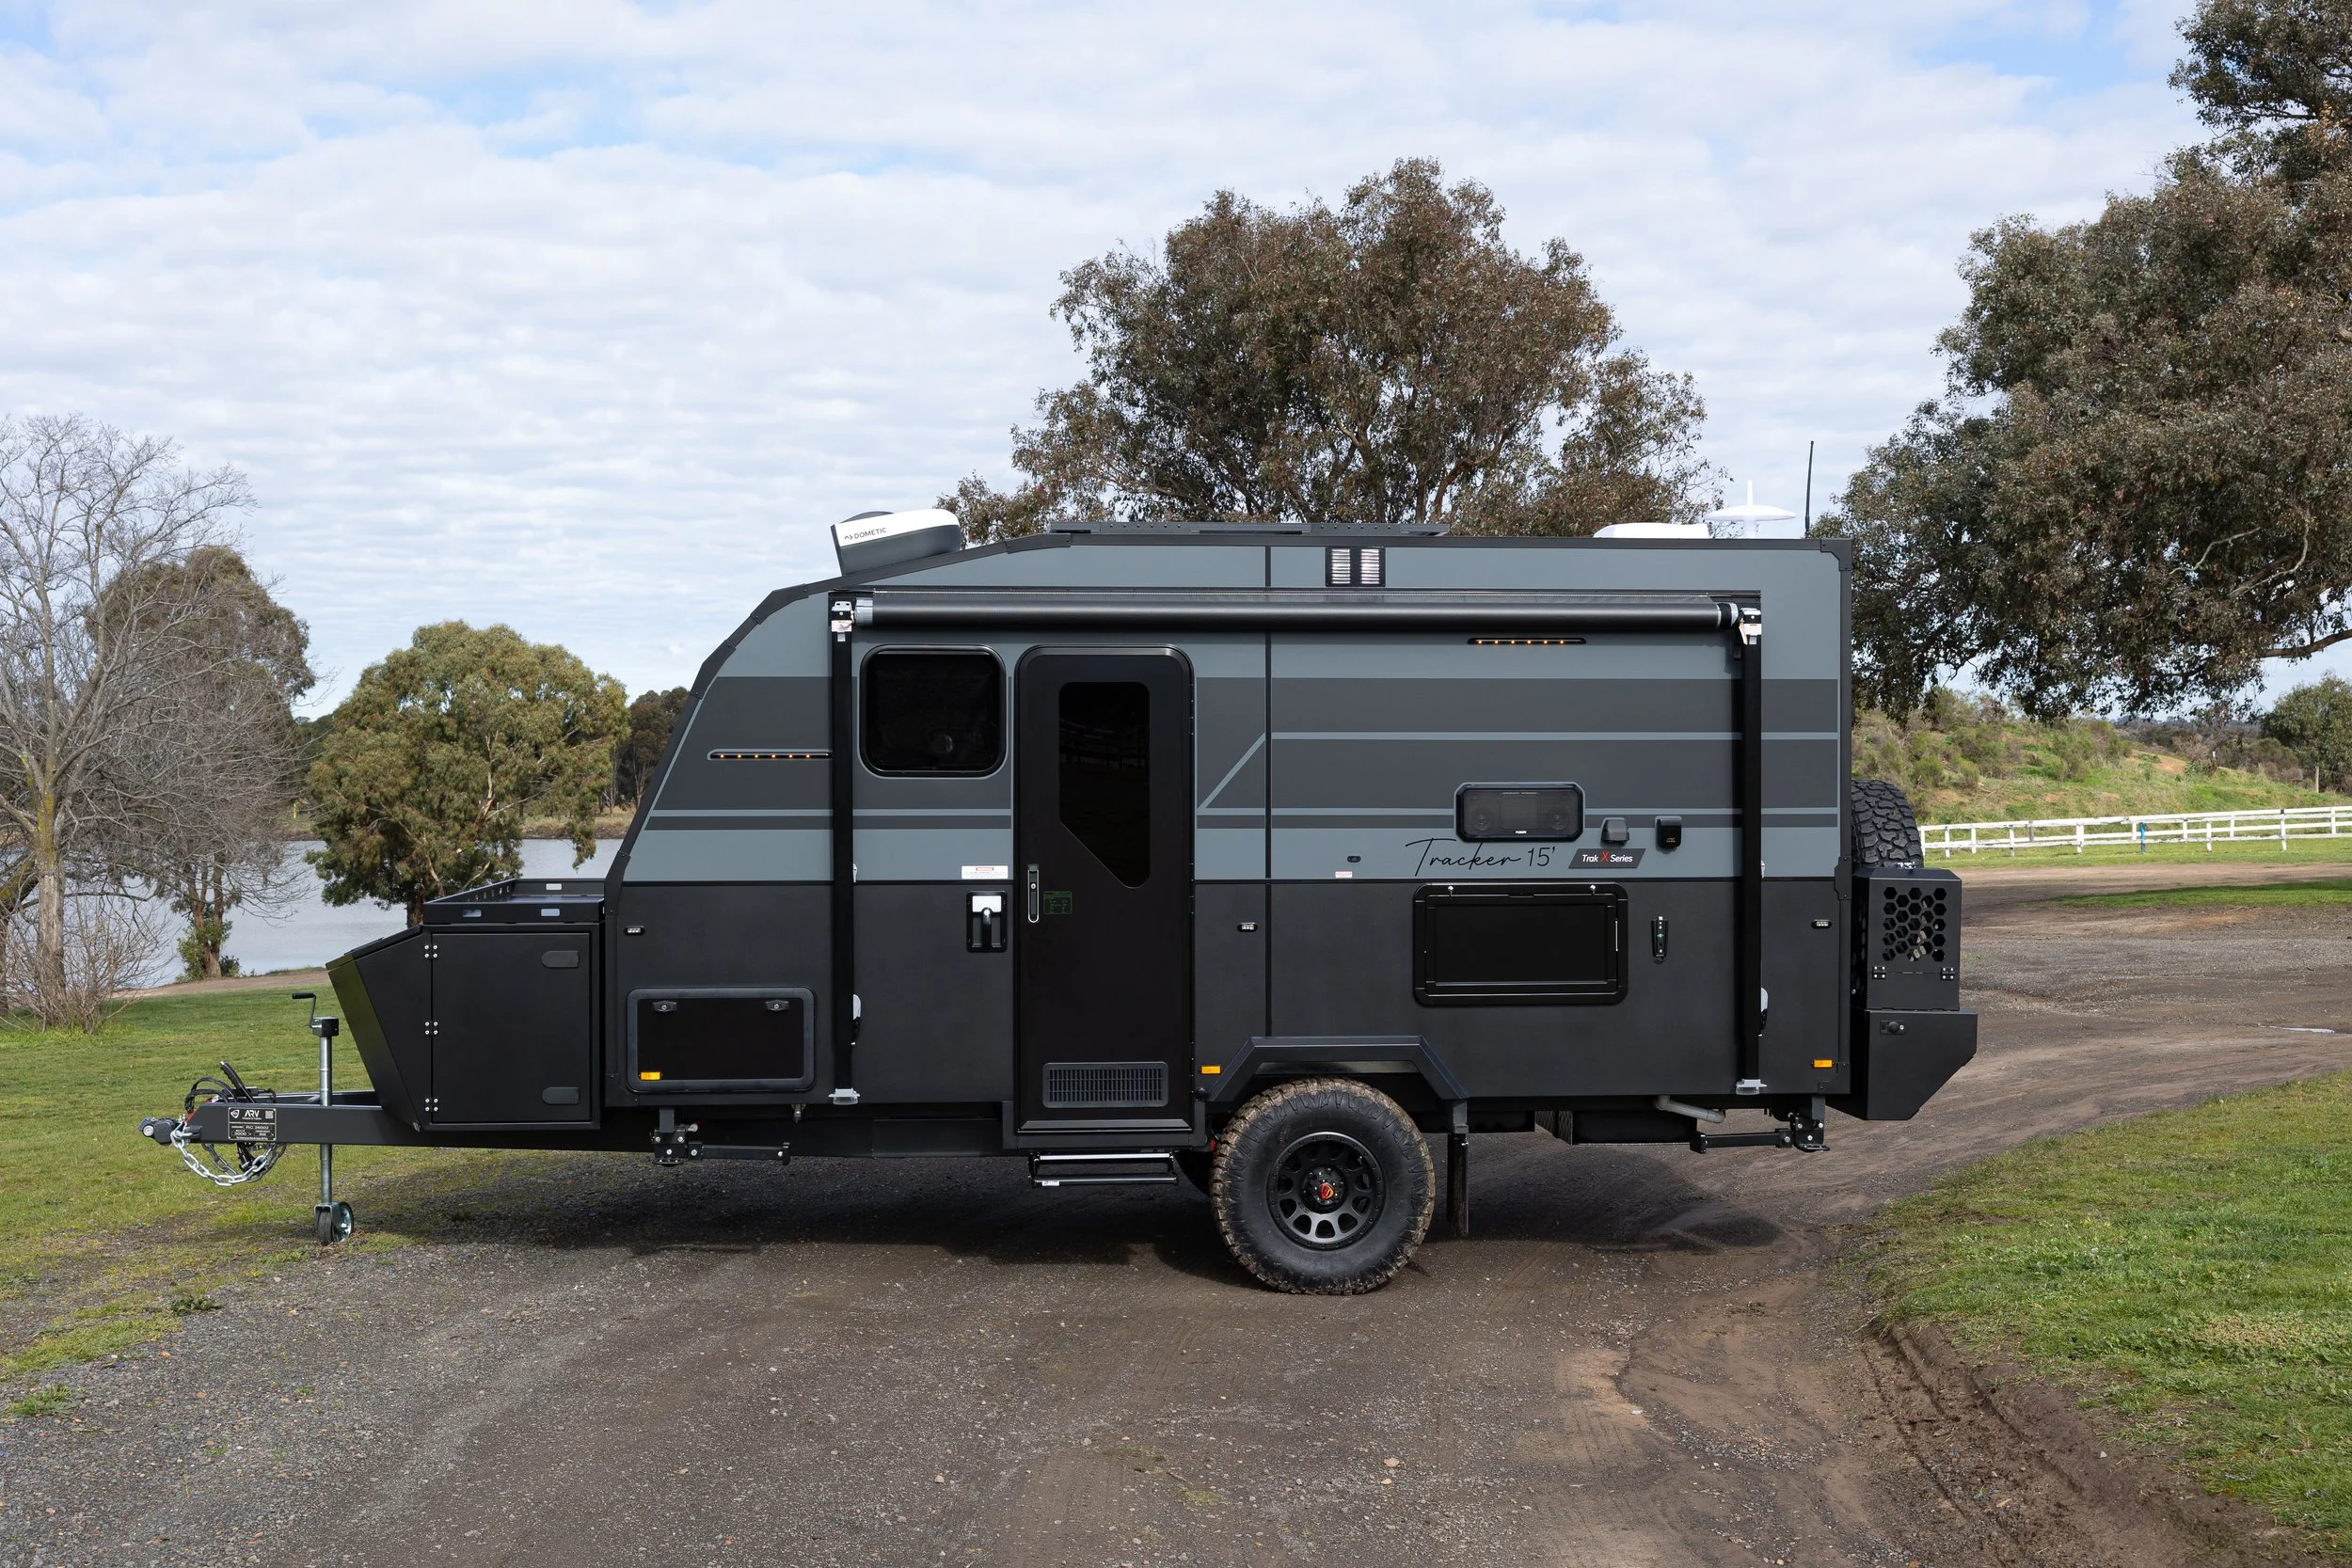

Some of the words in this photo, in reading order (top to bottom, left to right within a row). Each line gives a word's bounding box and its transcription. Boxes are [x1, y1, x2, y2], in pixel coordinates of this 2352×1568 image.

[853, 527, 887, 540] DOMETIC
[1405, 837, 1521, 877] Tracker
[1527, 846, 1556, 867] 15'
[1581, 854, 1599, 863] Trak
[1600, 850, 1610, 863] X
[1610, 854, 1633, 863] Series
[244, 1109, 260, 1117] ARV
